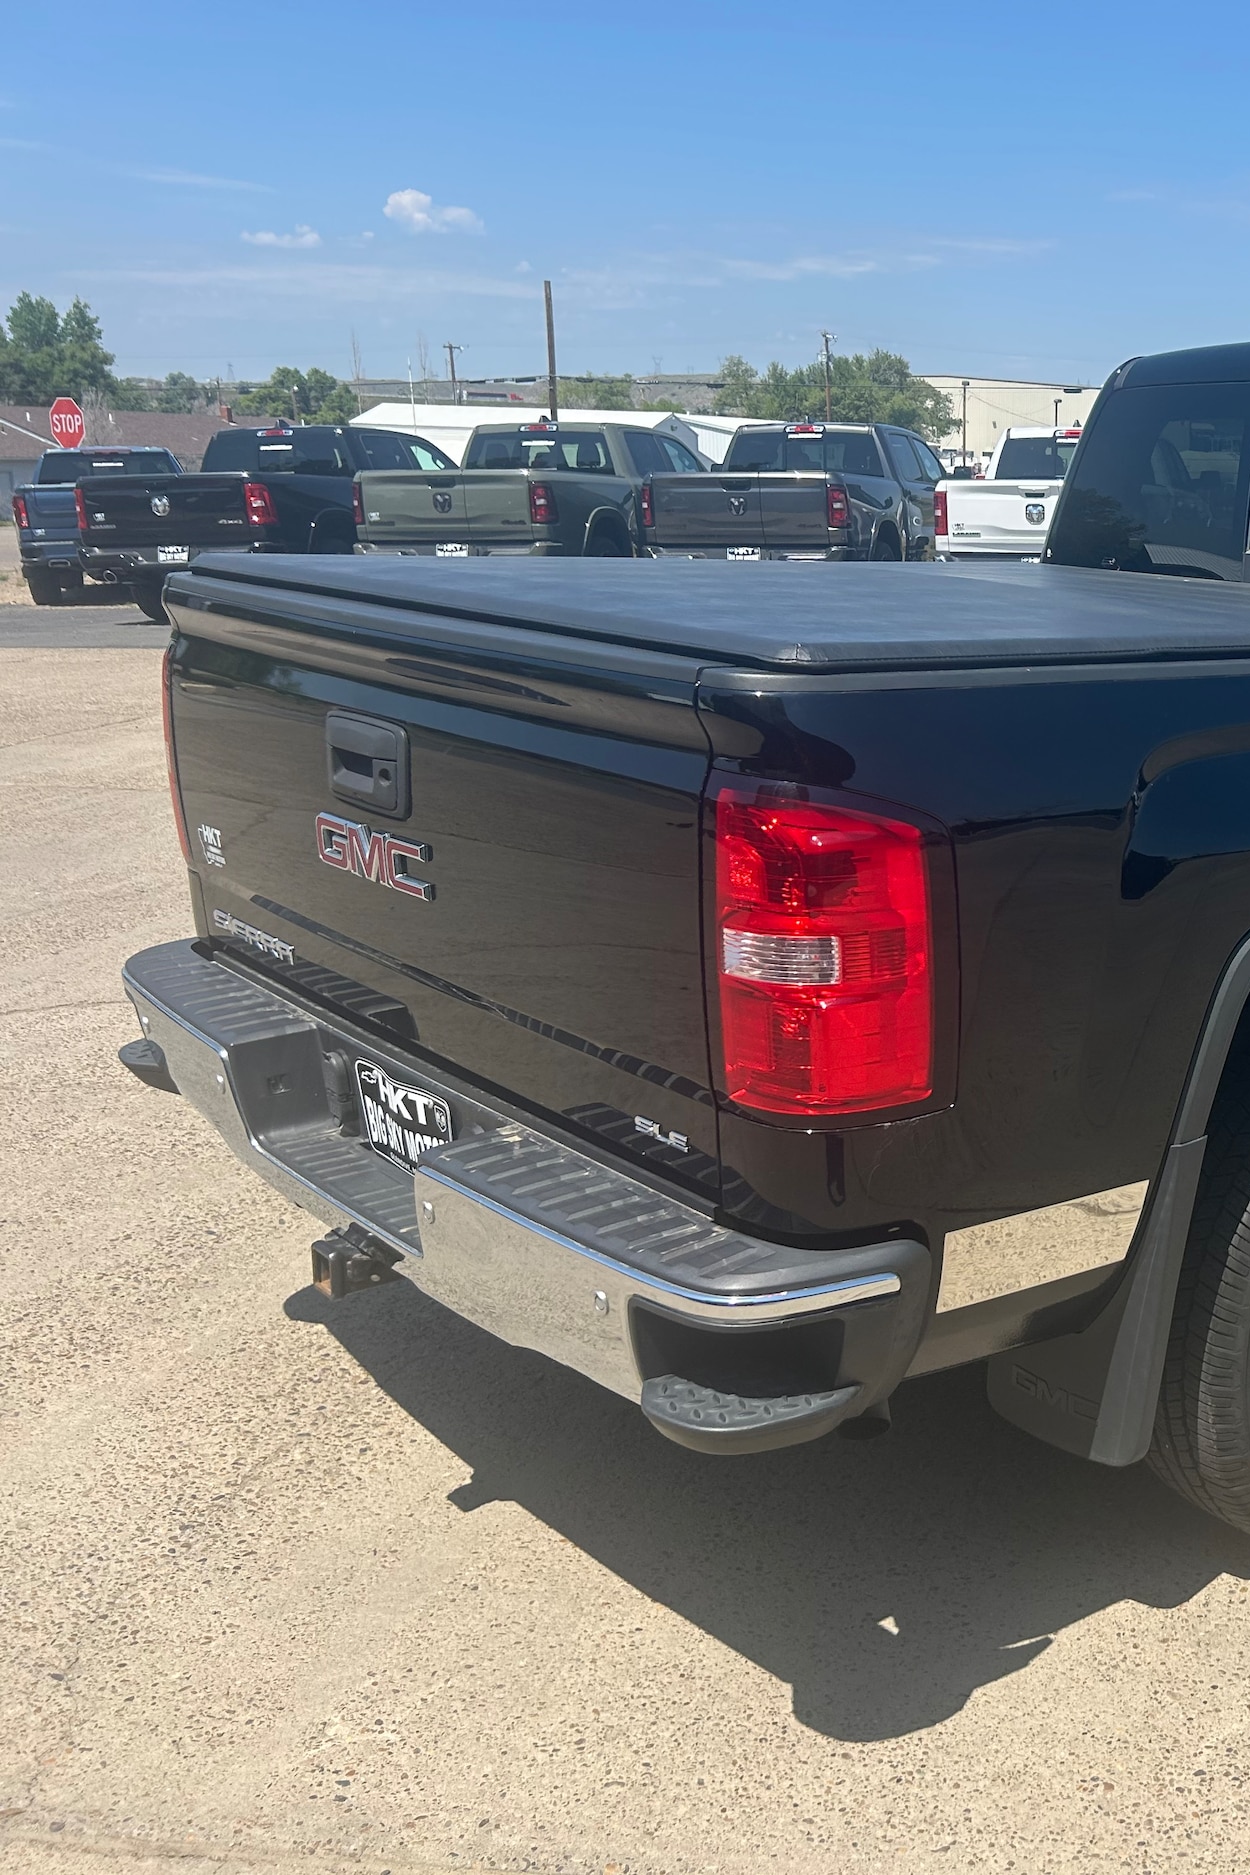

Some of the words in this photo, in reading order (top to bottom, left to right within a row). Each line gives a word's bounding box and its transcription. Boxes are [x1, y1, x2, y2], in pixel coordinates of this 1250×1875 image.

[52, 413, 82, 433] STOP
[202, 823, 222, 848] HKT
[316, 811, 434, 902] GMC
[213, 909, 295, 966] SIERRA
[365, 1094, 388, 1146] BIG
[385, 1112, 406, 1156] SKY
[378, 1071, 433, 1126] HKT
[634, 1115, 689, 1153] SLE
[1012, 1363, 1100, 1424] GMC
